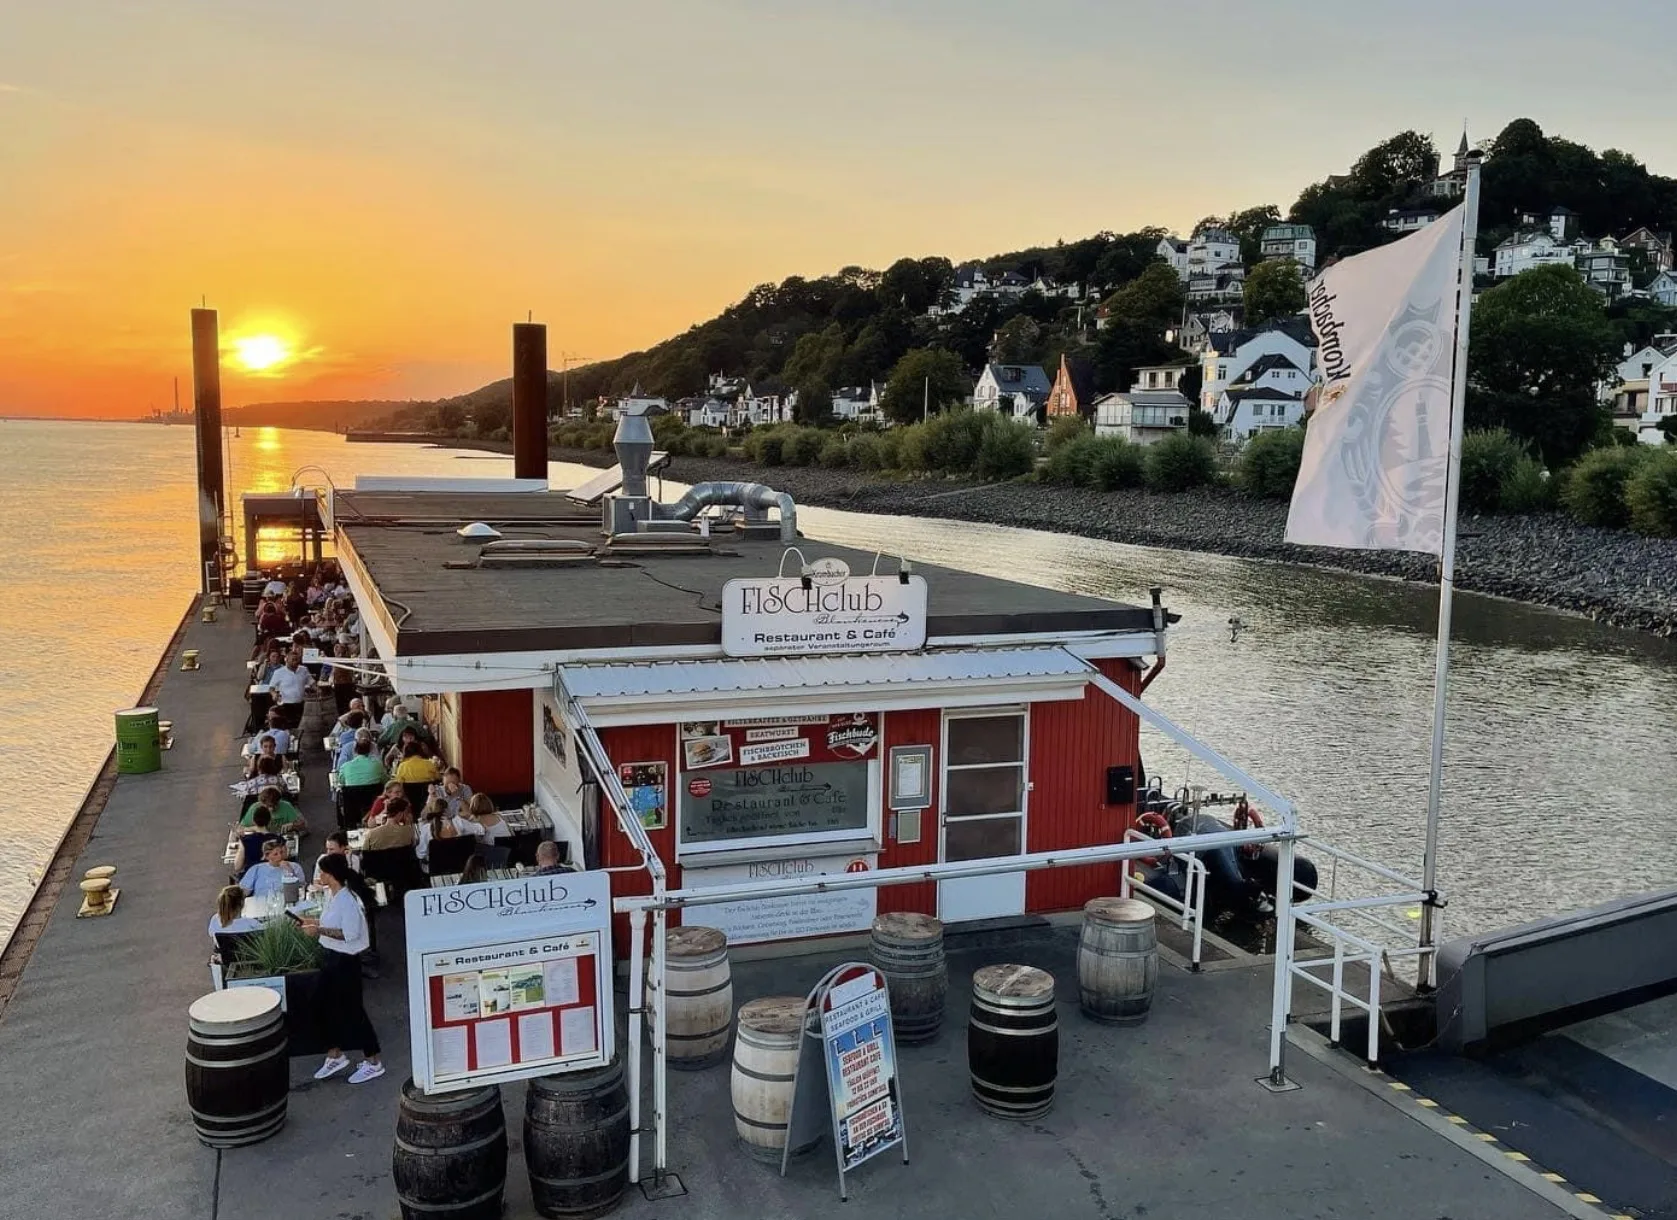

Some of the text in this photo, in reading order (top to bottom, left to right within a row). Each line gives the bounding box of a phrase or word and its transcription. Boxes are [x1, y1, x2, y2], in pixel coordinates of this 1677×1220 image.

[740, 582, 882, 615] FISCHclub
[754, 628, 896, 643] Restaurant & Café
[711, 796, 795, 812] Restaurant
[421, 880, 568, 917] FISCHclub
[455, 950, 525, 965] Restaurant
[529, 947, 538, 955] &
[542, 942, 569, 953] Café
